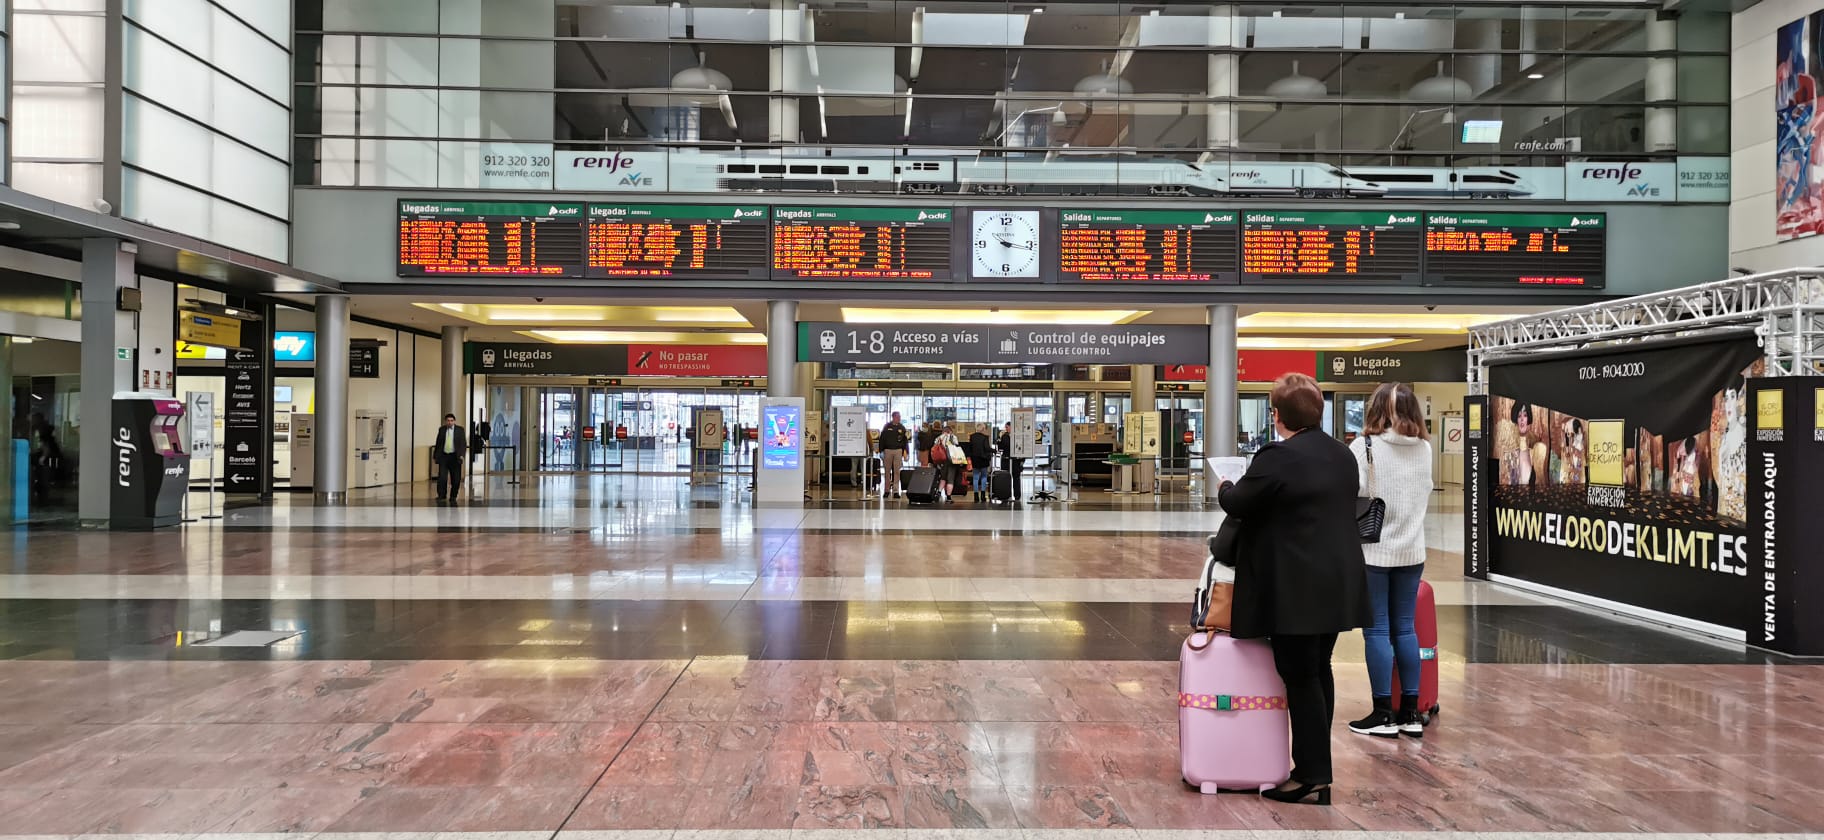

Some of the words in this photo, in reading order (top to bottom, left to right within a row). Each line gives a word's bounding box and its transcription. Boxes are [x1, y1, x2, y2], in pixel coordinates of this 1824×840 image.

[1514, 139, 1566, 151] renfe.com
[484, 155, 505, 167] 912
[507, 155, 528, 167] 320
[530, 156, 550, 168] 320
[573, 151, 634, 174] renfe
[484, 169, 550, 179] www.renfe.com
[618, 172, 653, 187] AVE
[1231, 170, 1261, 180] renfe
[1582, 161, 1642, 185] renfe
[1680, 172, 1697, 180] 912
[1699, 172, 1714, 180] 320
[1715, 172, 1729, 180] 320
[1627, 182, 1660, 197] AVE
[402, 204, 440, 214] Llegadas
[590, 207, 627, 217] Llegadas
[776, 209, 812, 220] Llegadas
[1000, 217, 1012, 226] 12
[1063, 213, 1092, 222] Salidas
[1246, 214, 1275, 223] Salidas
[1429, 215, 1458, 225] Salidas
[979, 240, 987, 248] 9
[1026, 241, 1034, 250] 3
[1002, 264, 1010, 272] 6
[847, 330, 885, 354] 1-8
[893, 330, 938, 344] Acceso
[941, 333, 949, 344] a
[953, 331, 980, 344] vías
[1028, 331, 1078, 345] Control
[1080, 331, 1097, 345] de
[1100, 332, 1166, 349] equipajes
[503, 349, 553, 361] Llegadas
[659, 350, 674, 361] No
[677, 352, 709, 363] pasar
[892, 346, 944, 355] PLATFORMS
[1028, 347, 1070, 355] LUGGAGE
[1071, 347, 1112, 355] CONTROL
[1353, 356, 1401, 369] Llegadas
[168, 402, 181, 410] renfe
[1593, 443, 1601, 453] EL
[1602, 441, 1618, 454] ORO
[112, 427, 137, 487] renfe
[164, 463, 184, 477] renfe
[1763, 452, 1777, 488] AQUÍ
[1587, 486, 1626, 498] EXPOSICIÓN
[1587, 496, 1625, 509] INMERSIVA
[1472, 523, 1478, 538] DE
[1764, 491, 1775, 569] ENTRADAS
[1495, 506, 1747, 577] WWW.ELORODEKLIMT.ES
[1764, 572, 1775, 591] DE
[1764, 594, 1776, 641] VENTA
